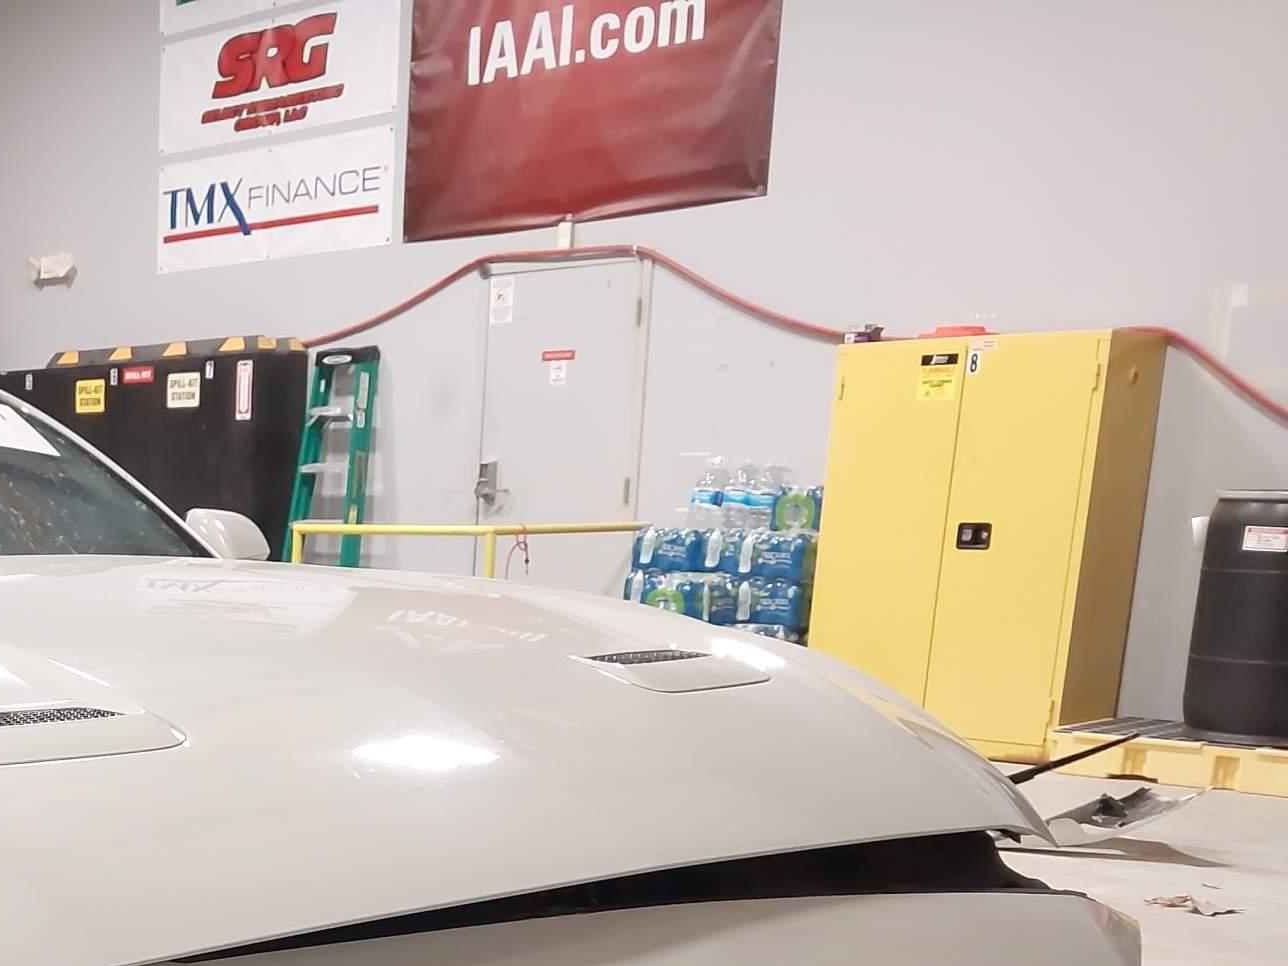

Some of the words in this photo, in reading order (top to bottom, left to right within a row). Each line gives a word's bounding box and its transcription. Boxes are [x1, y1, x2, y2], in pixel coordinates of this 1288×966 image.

[212, 12, 338, 99] SRG
[468, 0, 706, 85] IAAI.com
[163, 177, 252, 236] TMX
[248, 166, 381, 209] FINANCE
[969, 353, 978, 373] 8
